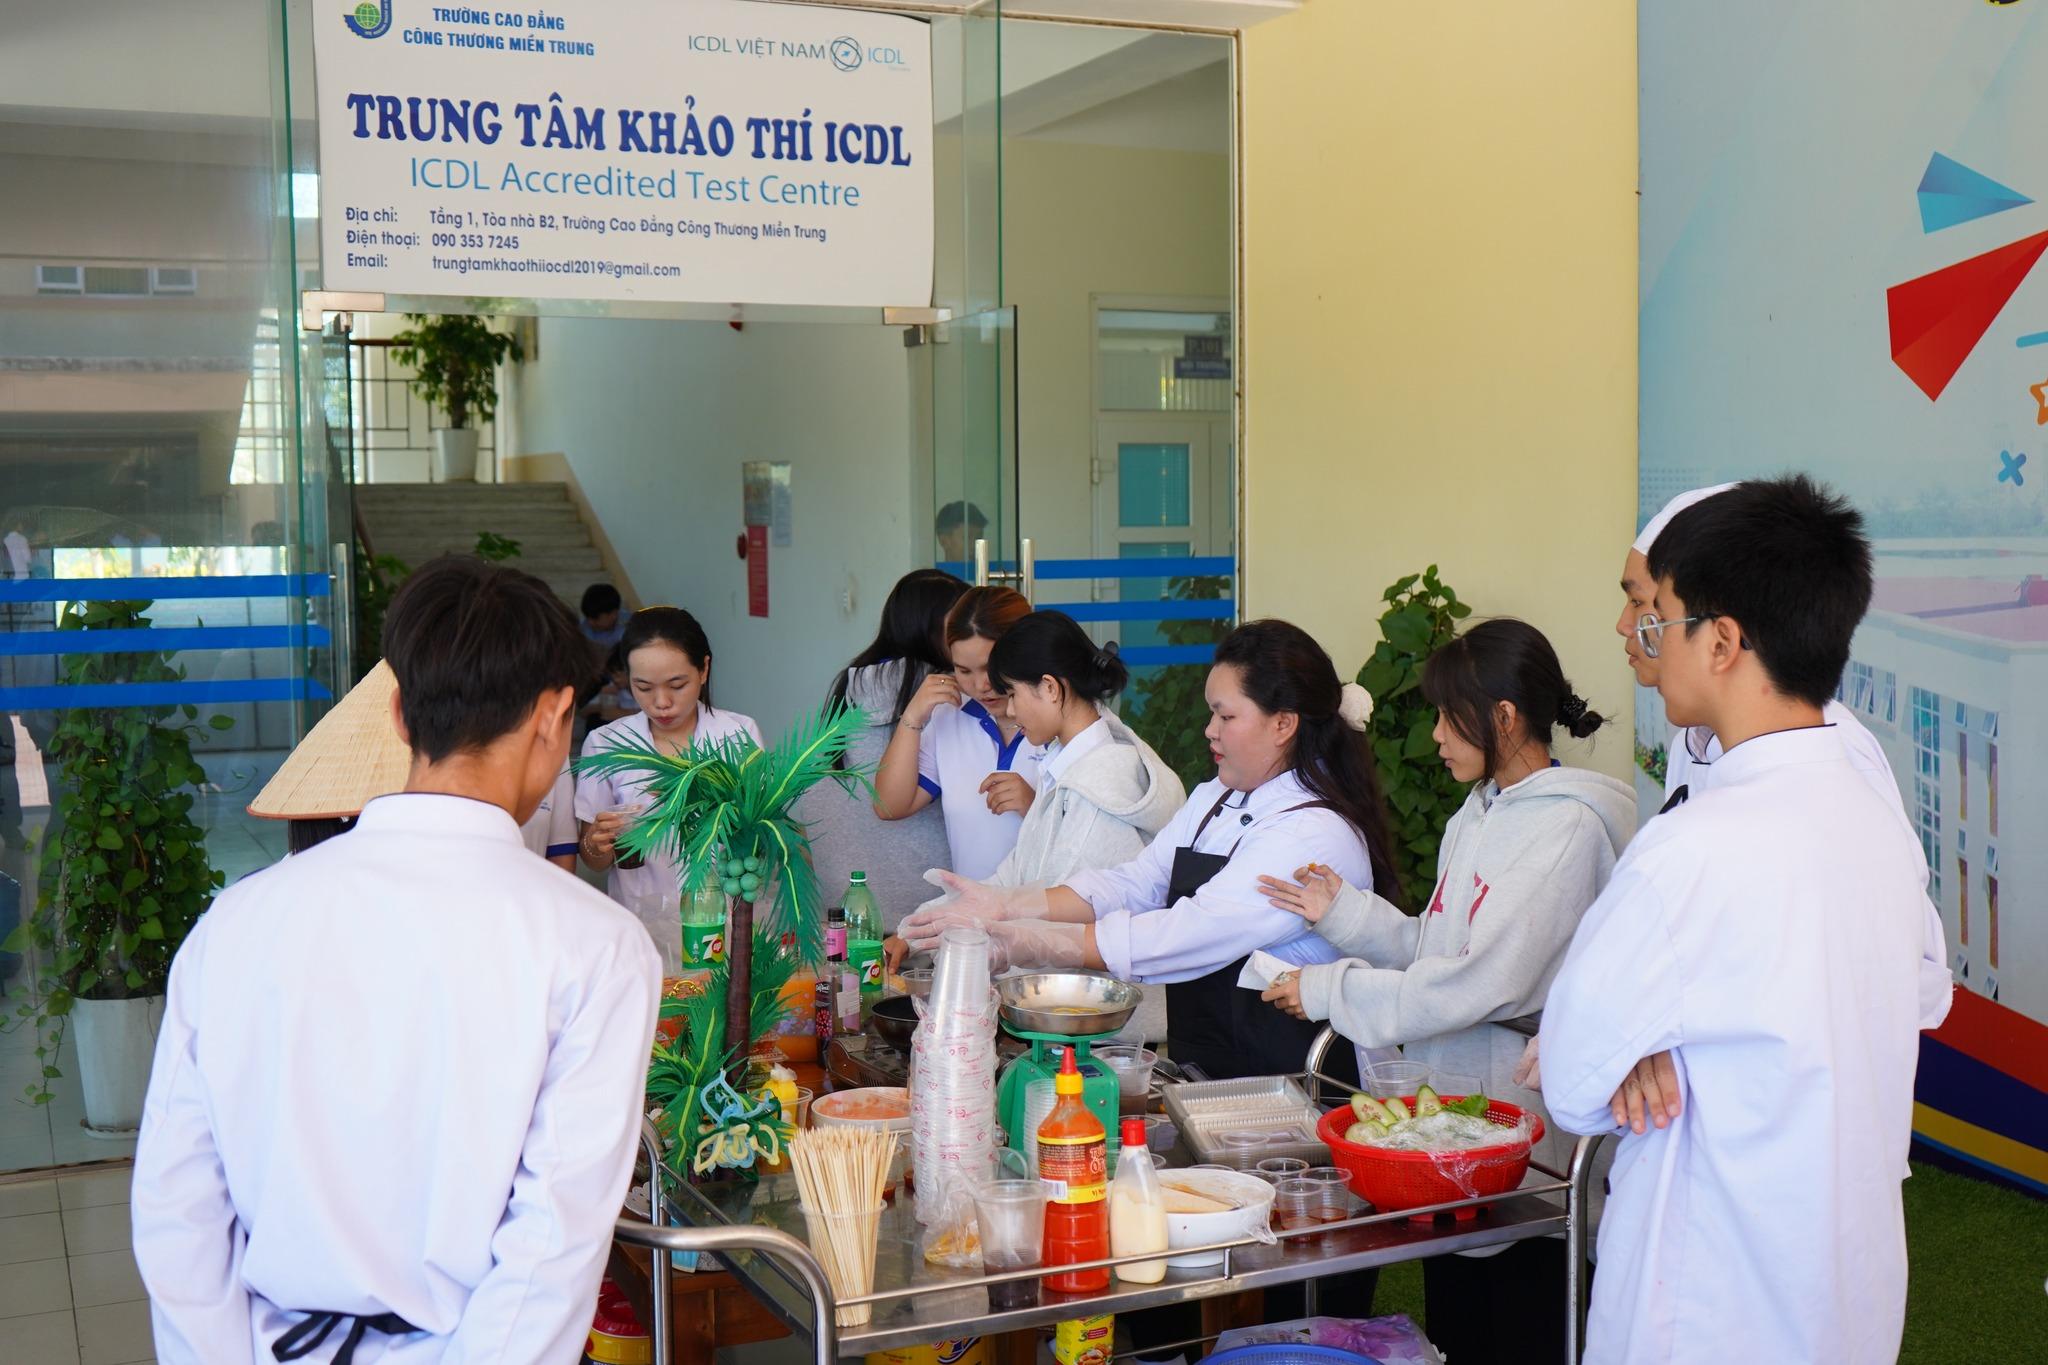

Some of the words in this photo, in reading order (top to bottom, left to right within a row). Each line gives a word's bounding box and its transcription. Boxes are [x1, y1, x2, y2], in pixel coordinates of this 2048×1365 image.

[433, 7, 489, 25] TRƯỜNG
[495, 13, 522, 27] CAO
[404, 27, 443, 45] CÔNG
[447, 33, 504, 49] THƯƠNG
[549, 40, 594, 56] TRUNG
[689, 35, 732, 52] ICDL
[736, 37, 776, 58] VIỆT
[782, 42, 825, 59] NAM
[868, 48, 905, 64] ICDL
[347, 93, 502, 145] TRUNG
[515, 92, 606, 150] TÂM
[618, 95, 734, 157] KHẢO
[746, 108, 813, 161] THÍ
[824, 122, 911, 166] ICDL
[412, 158, 490, 190] ICDL
[501, 163, 675, 198] Accredited
[685, 171, 750, 202] Test
[760, 175, 859, 206] Centre
[346, 207, 368, 224] Địa
[373, 207, 397, 222] chỉ:
[430, 207, 462, 229] Tầng
[468, 212, 478, 227] 1,
[483, 212, 506, 226] Tòa
[511, 214, 535, 227] nhà
[540, 215, 558, 230] B2,
[562, 216, 605, 234] Trường
[610, 218, 636, 231] Cao
[678, 220, 710, 238] Công
[714, 222, 758, 240] Thương
[794, 225, 826, 242] Trung
[346, 230, 377, 247] Điện
[381, 231, 420, 249] thoại:
[432, 233, 456, 247] 090
[461, 234, 483, 248] 353
[488, 235, 519, 249] 7245
[348, 253, 387, 267] Email:
